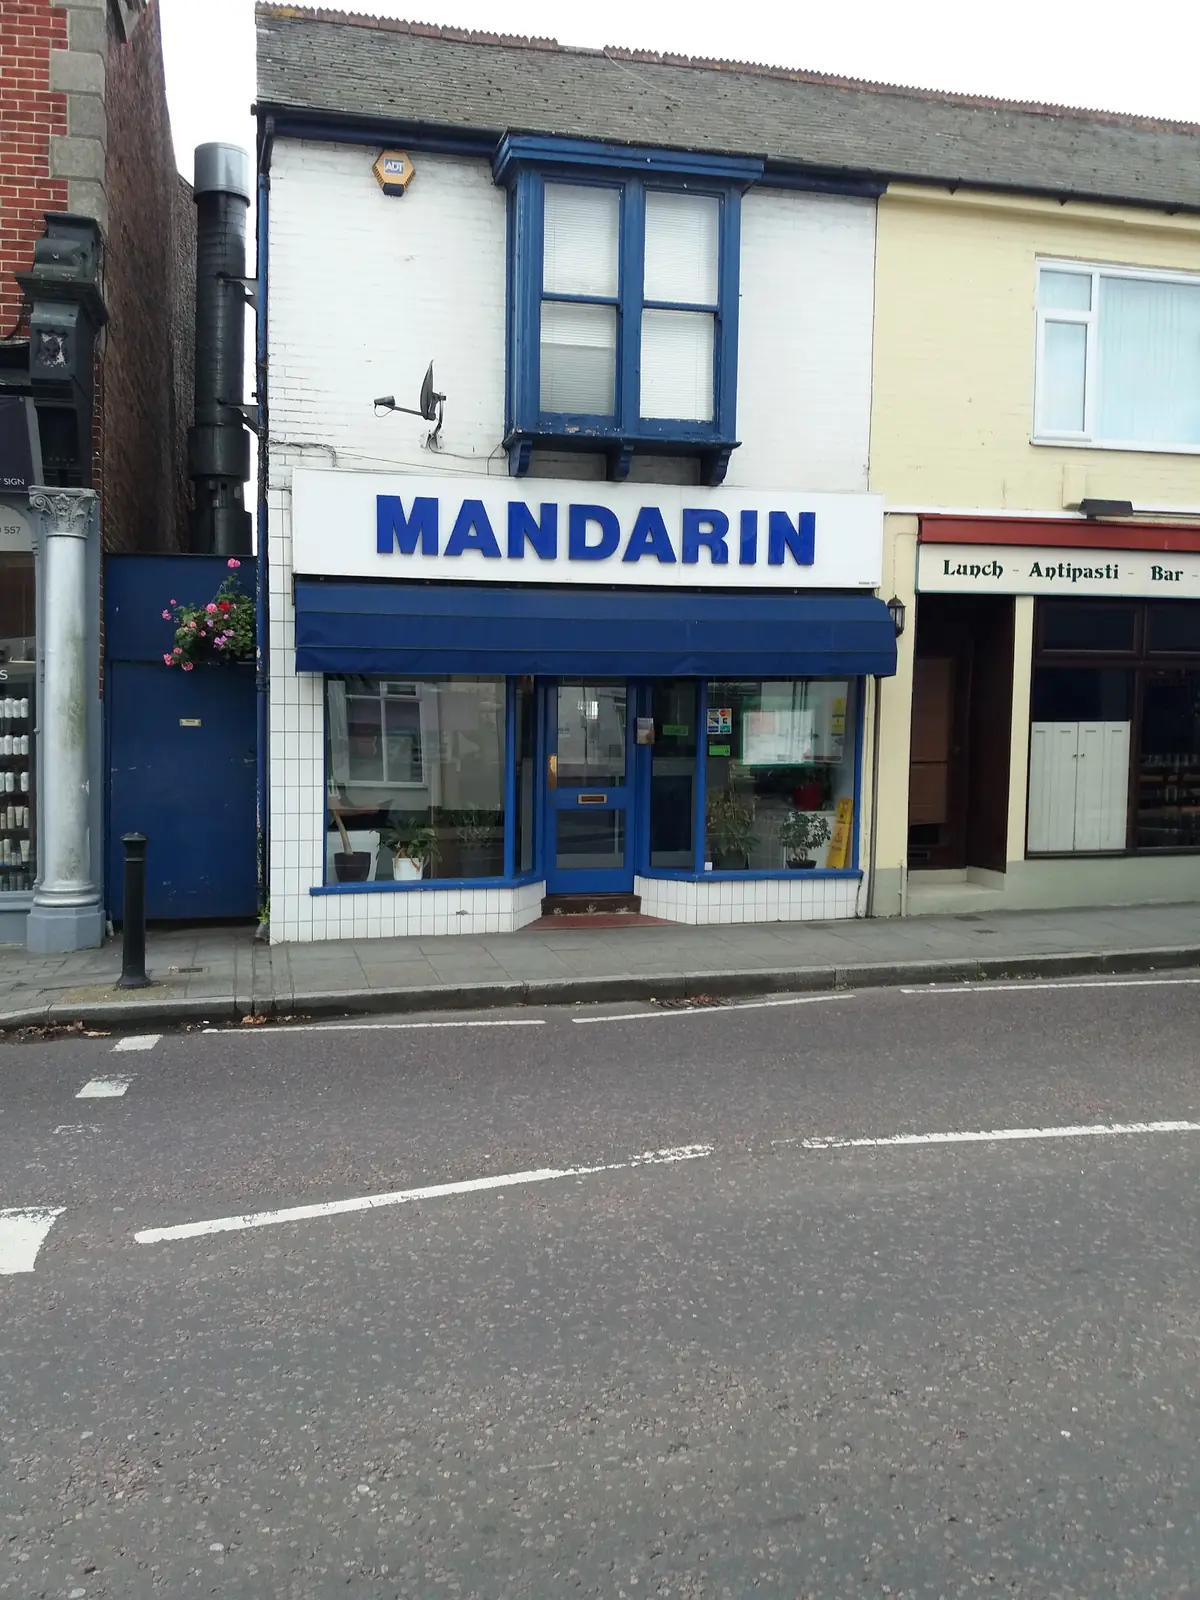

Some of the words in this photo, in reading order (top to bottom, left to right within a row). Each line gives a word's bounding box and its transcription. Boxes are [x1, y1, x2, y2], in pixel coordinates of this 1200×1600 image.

[385, 161, 404, 172] ADT
[3, 477, 25, 486] SIGN
[4, 526, 21, 535] 557
[376, 494, 816, 565] MANDARIN
[943, 559, 1004, 579] Lunch
[1029, 561, 1119, 582] Antipasti
[1150, 565, 1184, 582] Bar
